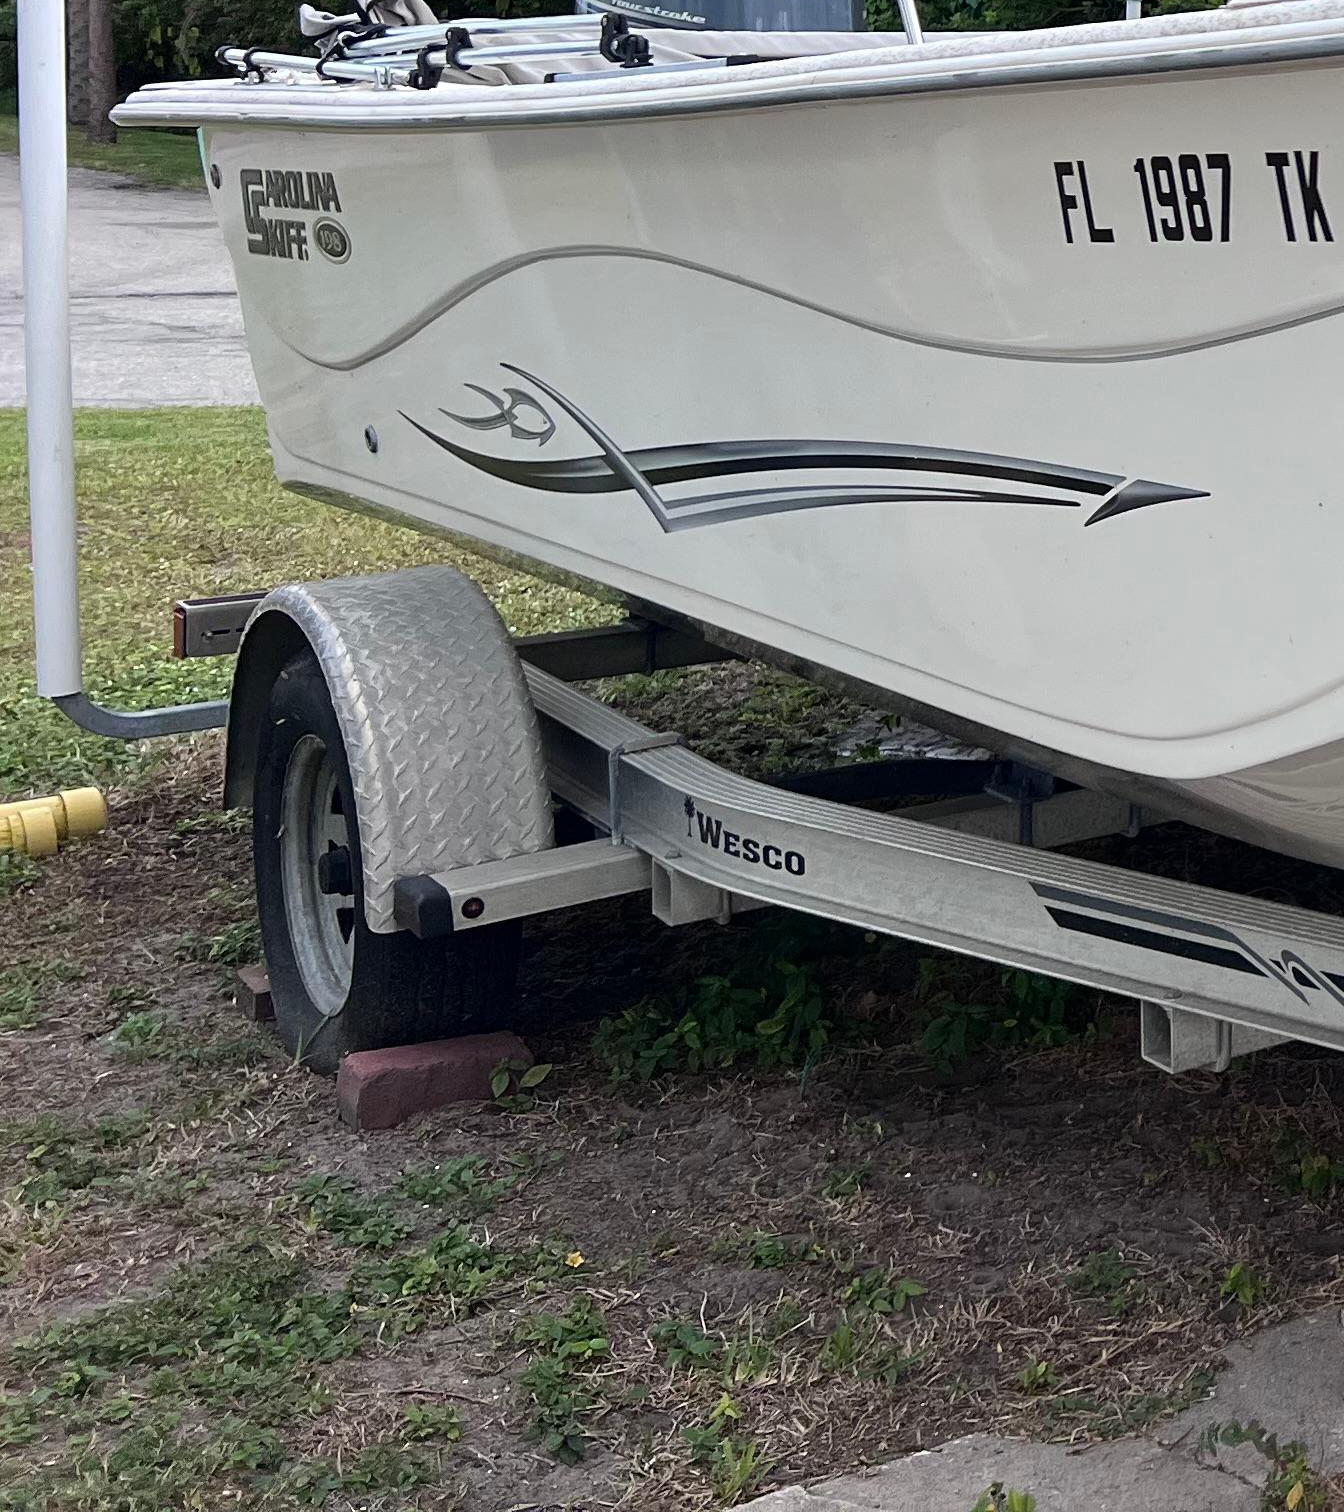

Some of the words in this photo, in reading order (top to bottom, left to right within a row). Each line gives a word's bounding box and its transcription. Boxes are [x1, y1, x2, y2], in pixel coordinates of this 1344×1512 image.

[240, 168, 342, 230] CAROLINA
[247, 194, 306, 261] SKIFF
[319, 229, 343, 253] 198
[1053, 159, 1116, 244] FL
[1133, 153, 1232, 243] 1987
[1265, 150, 1335, 243] TK
[696, 809, 806, 876] WESCO
